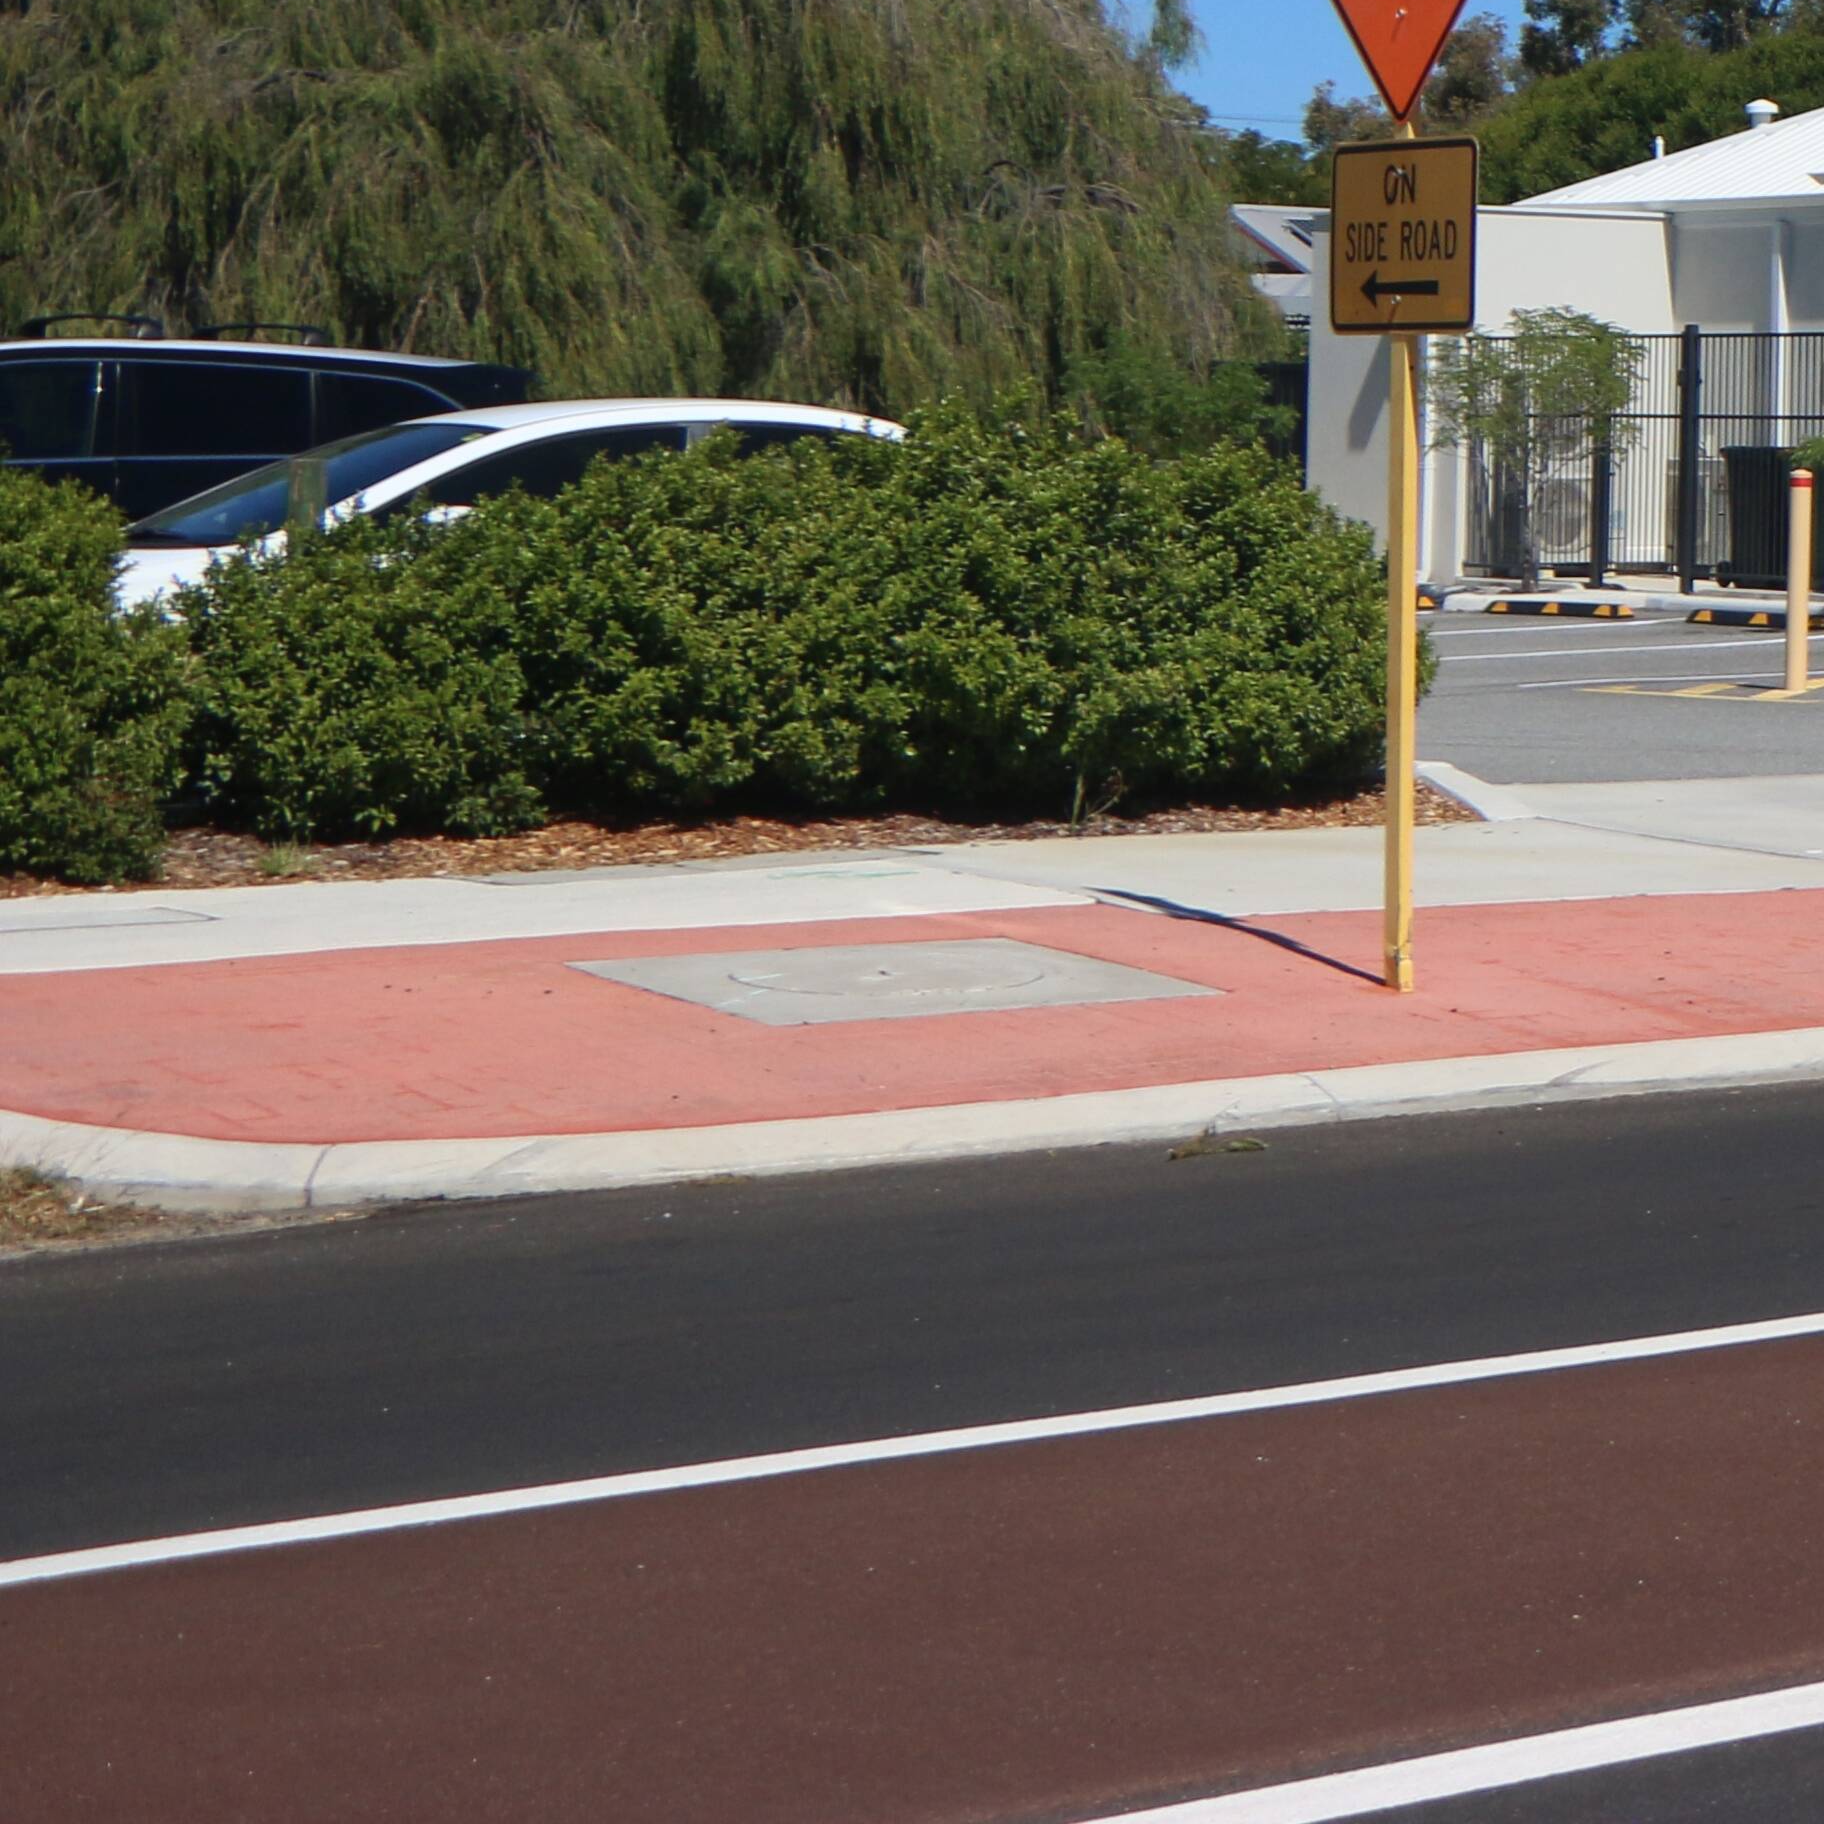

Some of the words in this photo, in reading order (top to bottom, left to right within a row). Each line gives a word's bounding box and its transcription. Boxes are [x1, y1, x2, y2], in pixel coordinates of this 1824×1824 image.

[1384, 164, 1416, 205] ON
[1345, 221, 1388, 263] SIDE
[1400, 219, 1457, 261] ROAD
